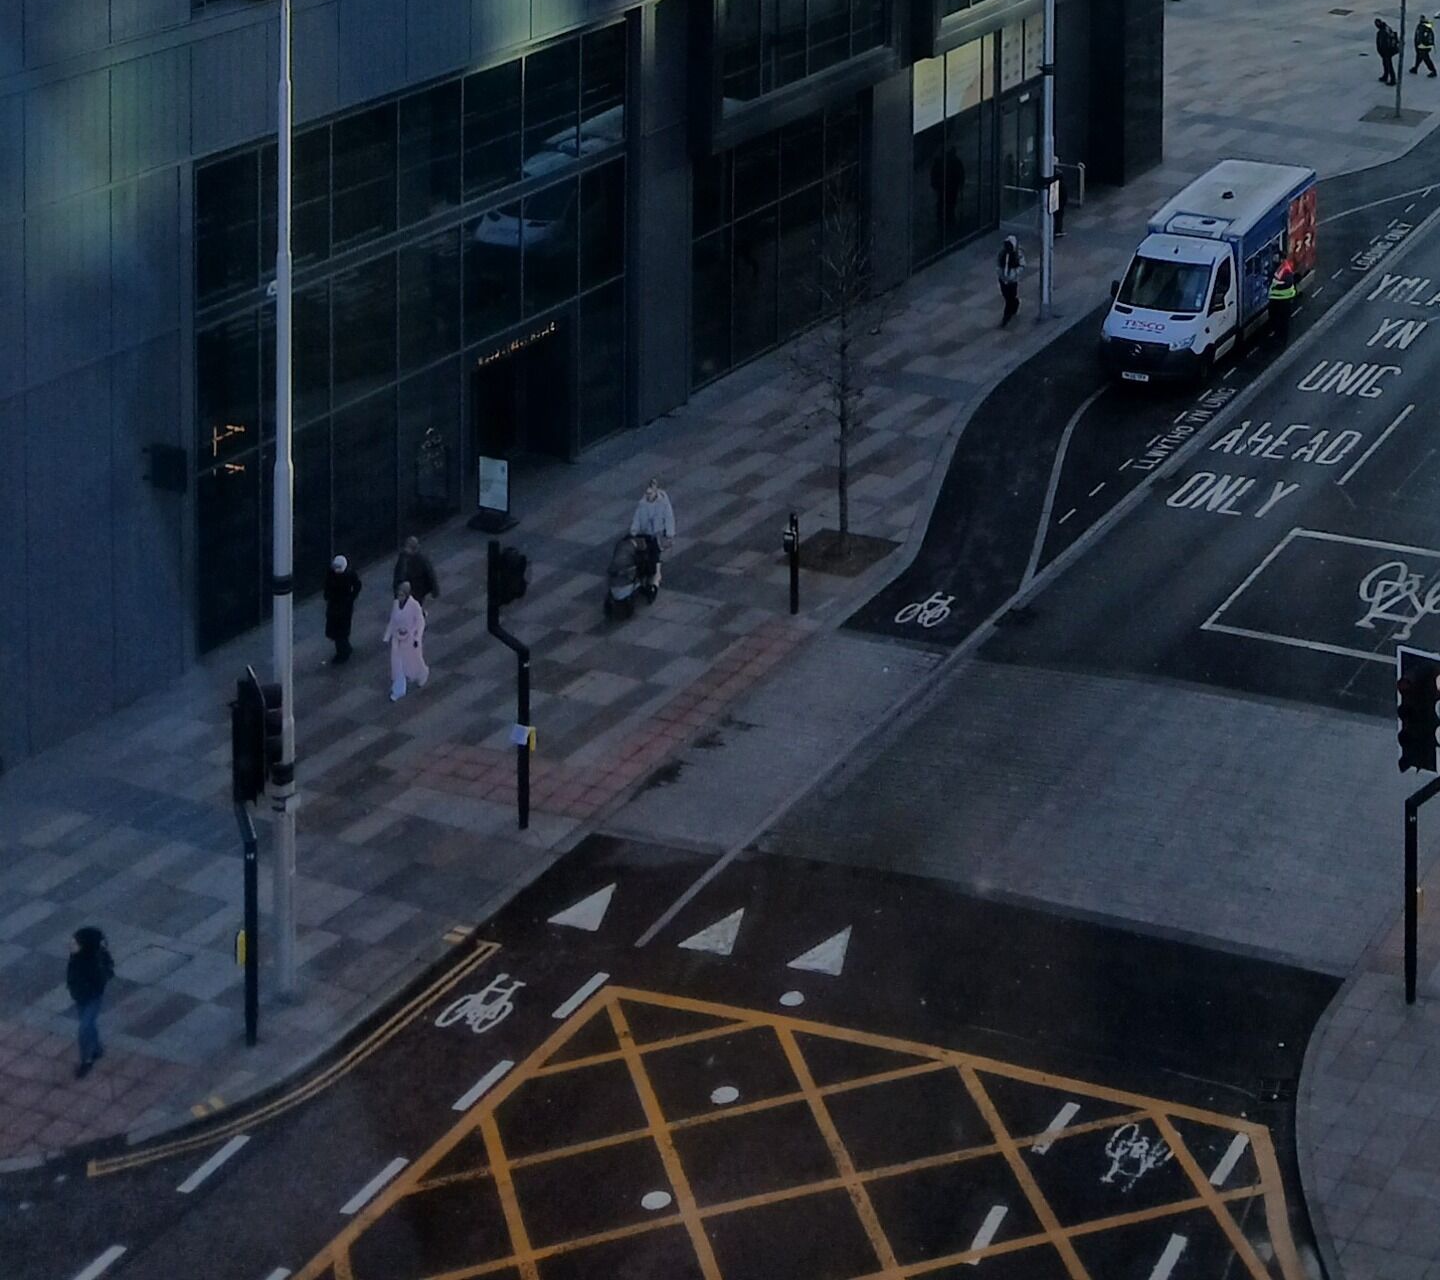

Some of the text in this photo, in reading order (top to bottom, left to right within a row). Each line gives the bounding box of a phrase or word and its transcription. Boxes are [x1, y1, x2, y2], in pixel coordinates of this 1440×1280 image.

[1124, 319, 1166, 331] TESCO
[1366, 318, 1428, 350] YN
[1297, 360, 1402, 398] UNIG
[1209, 420, 1363, 465] AHEAD
[1166, 472, 1300, 518] ONLY
